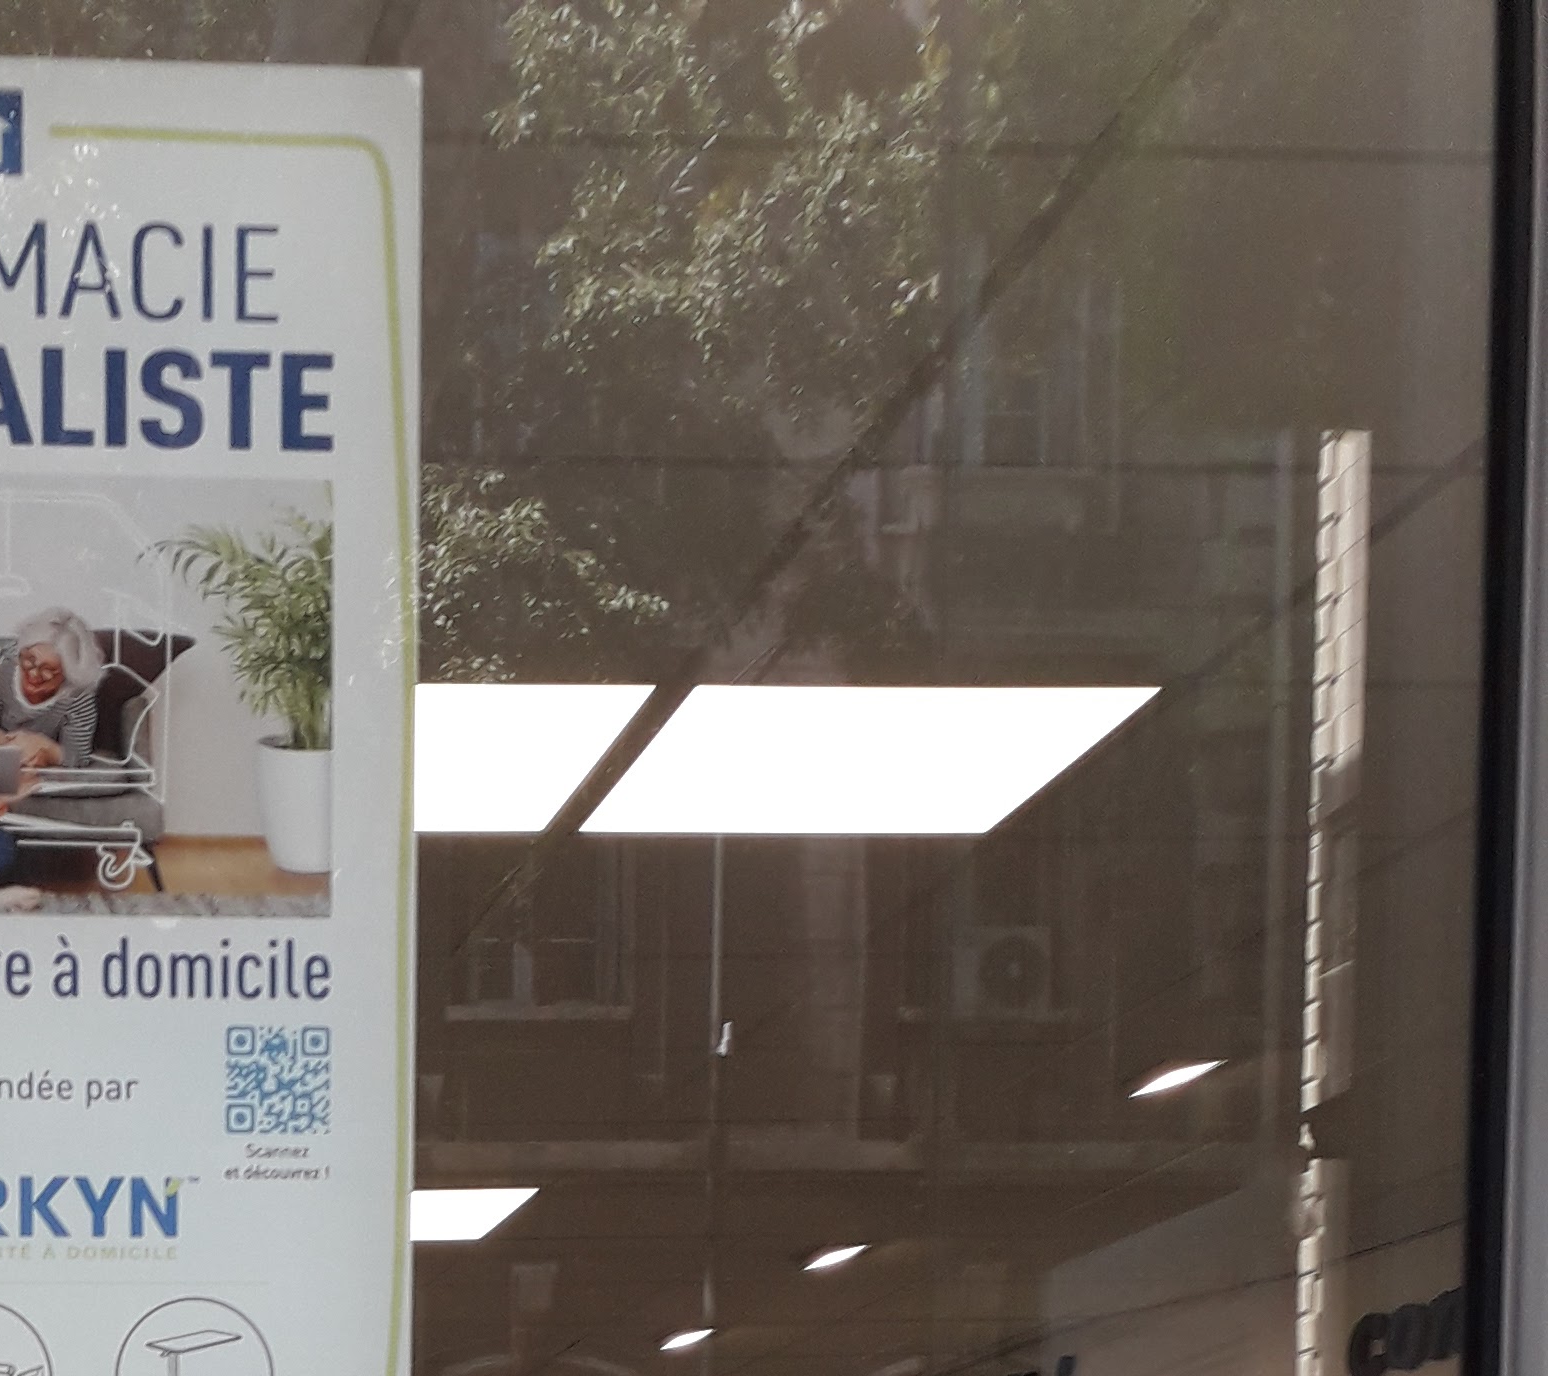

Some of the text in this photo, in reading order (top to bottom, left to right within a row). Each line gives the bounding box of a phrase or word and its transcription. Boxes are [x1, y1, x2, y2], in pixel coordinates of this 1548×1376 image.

[53, 937, 81, 999] à
[101, 937, 332, 1000] domicile
[85, 1074, 140, 1110] par
